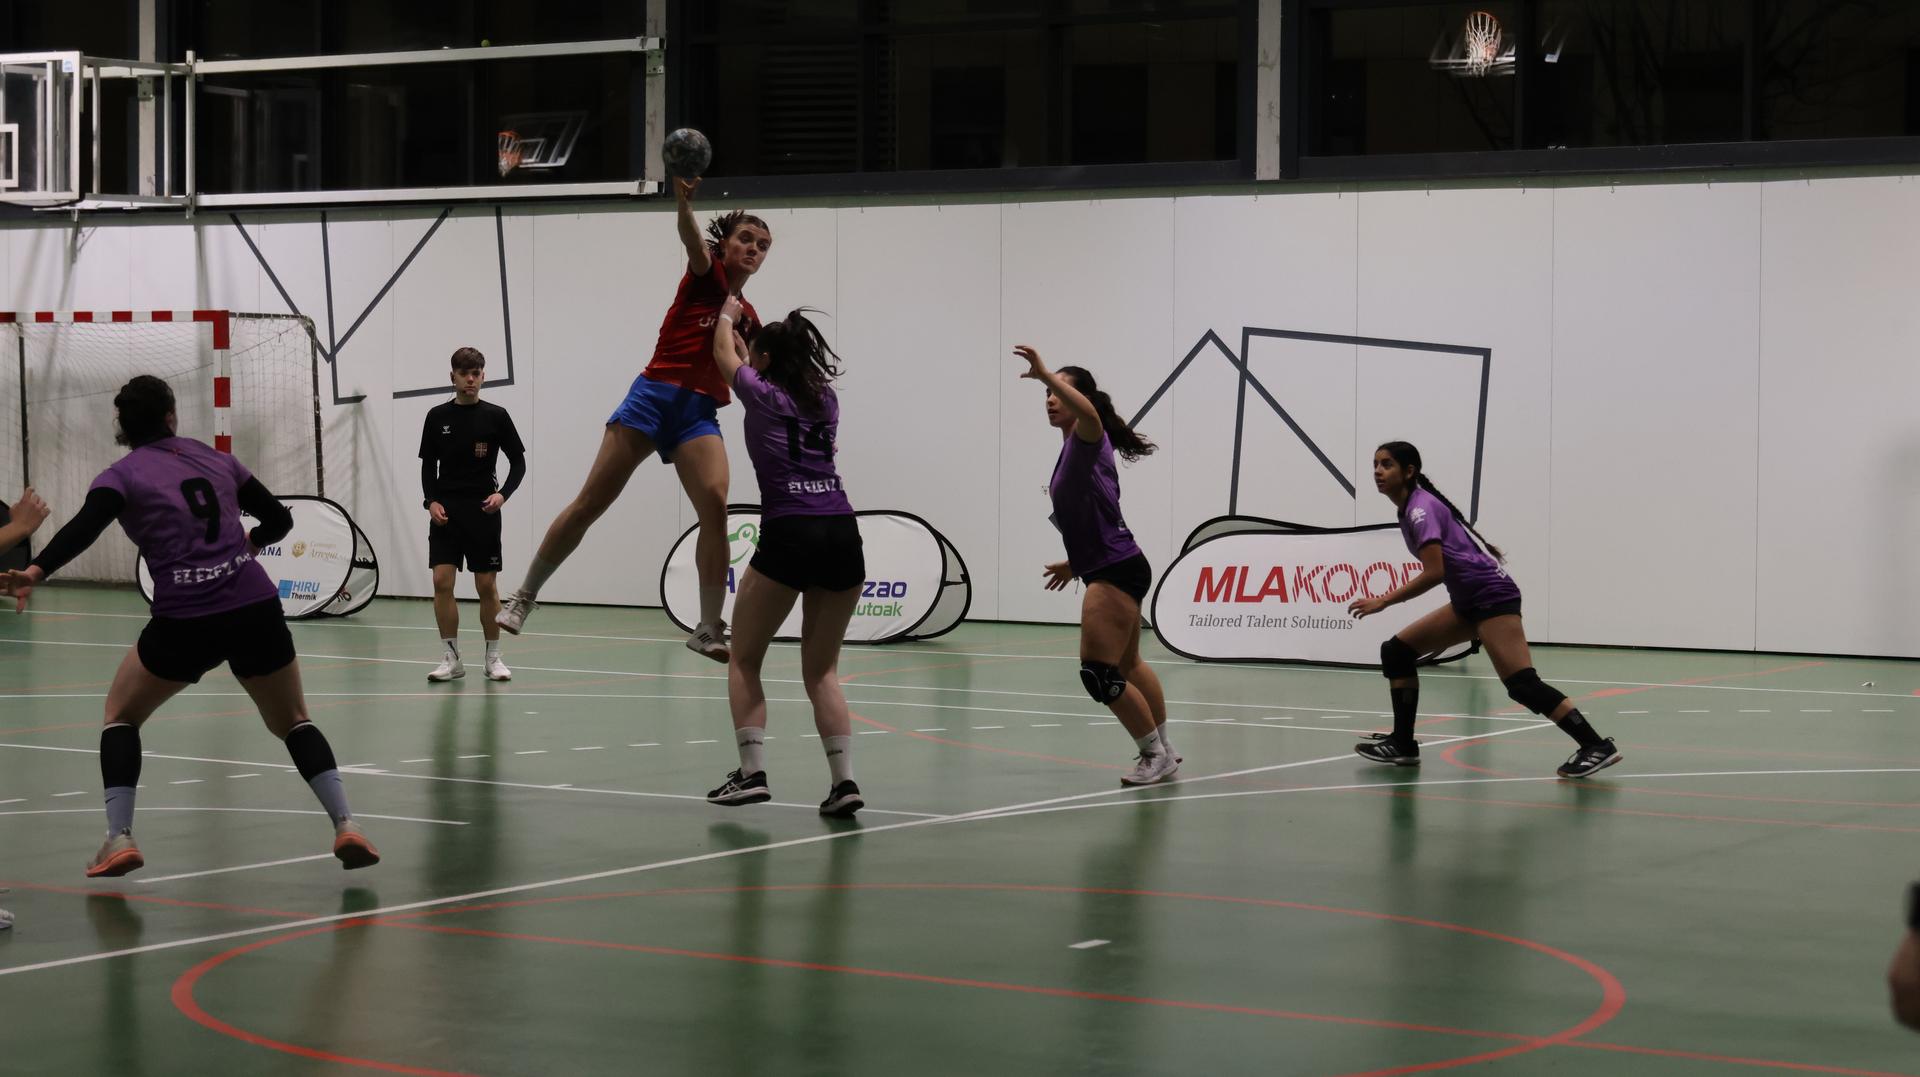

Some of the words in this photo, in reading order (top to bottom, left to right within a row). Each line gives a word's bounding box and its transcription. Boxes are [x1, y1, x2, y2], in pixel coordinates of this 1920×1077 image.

[181, 477, 220, 543] 9
[292, 581, 320, 592] HIRU
[291, 592, 317, 601] Thermik
[1189, 614, 1241, 628] Tailored
[1246, 615, 1288, 629] Talent
[1291, 615, 1354, 630] Solutions
